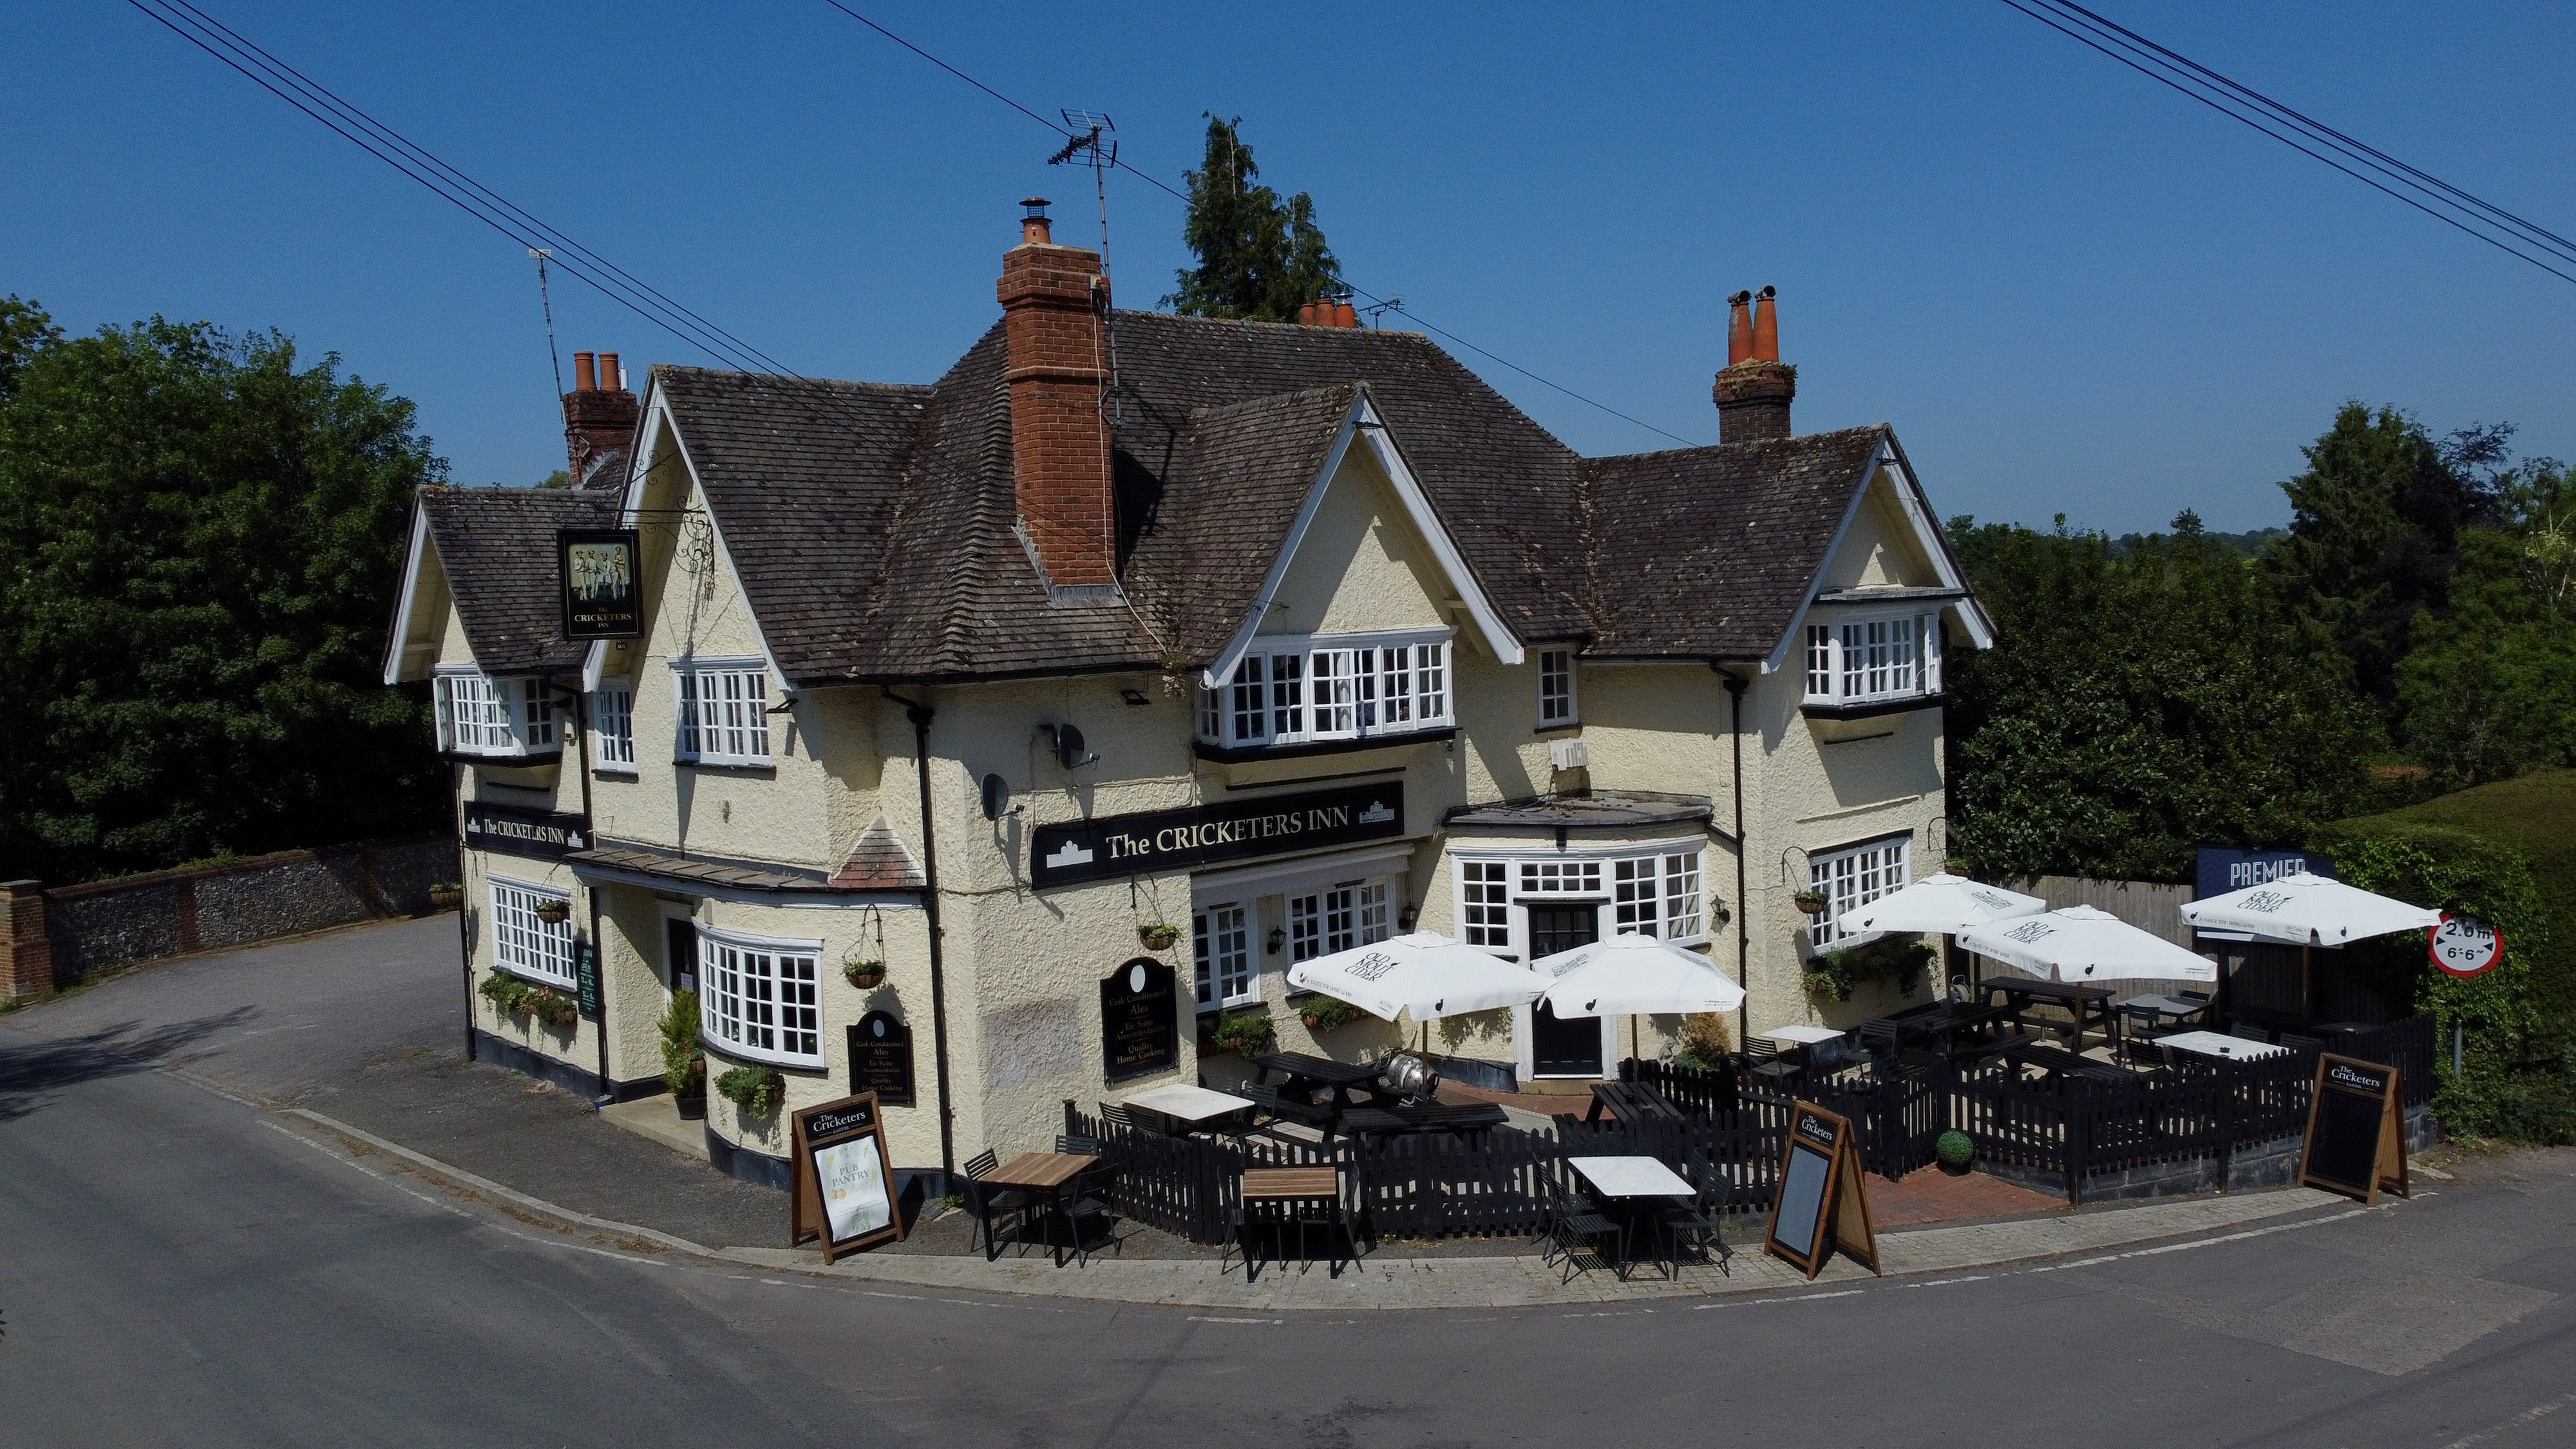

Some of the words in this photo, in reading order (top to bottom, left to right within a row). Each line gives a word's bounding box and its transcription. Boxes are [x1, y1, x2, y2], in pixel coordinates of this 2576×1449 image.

[574, 613, 632, 622] CRICKETERS
[484, 819, 497, 835] The
[498, 820, 547, 842] CRICKETERS
[547, 827, 565, 845] INN
[1106, 833, 1150, 859] The
[1157, 811, 1302, 853] CRICKETERS
[1307, 805, 1349, 831] INN
[2246, 896, 2289, 907] MOUT
[2253, 891, 2280, 899] OLD
[2237, 902, 2279, 913] CIDER
[2003, 931, 2038, 945] CIDER
[1365, 952, 1391, 963] OLD
[1354, 958, 1395, 974] MOUT
[1344, 965, 1383, 983] CIDER
[1110, 996, 1125, 1007] Cask
[1127, 988, 1167, 1003] Conditioned
[1130, 1004, 1148, 1015] Ales
[1115, 1025, 1166, 1041] Accommodation
[1128, 1043, 1153, 1054] Quality
[1117, 1054, 1136, 1065] Home
[1139, 1048, 1166, 1059] Cooking
[2339, 1065, 2353, 1074] The
[2331, 1068, 2380, 1088] Cricketers
[813, 1112, 866, 1132] Cricketers
[819, 1114, 834, 1122] The
[1808, 1115, 1817, 1124] The
[1801, 1119, 1833, 1141] Cricketers
[839, 1163, 859, 1176] PUB
[832, 1169, 869, 1187] PANTRY
